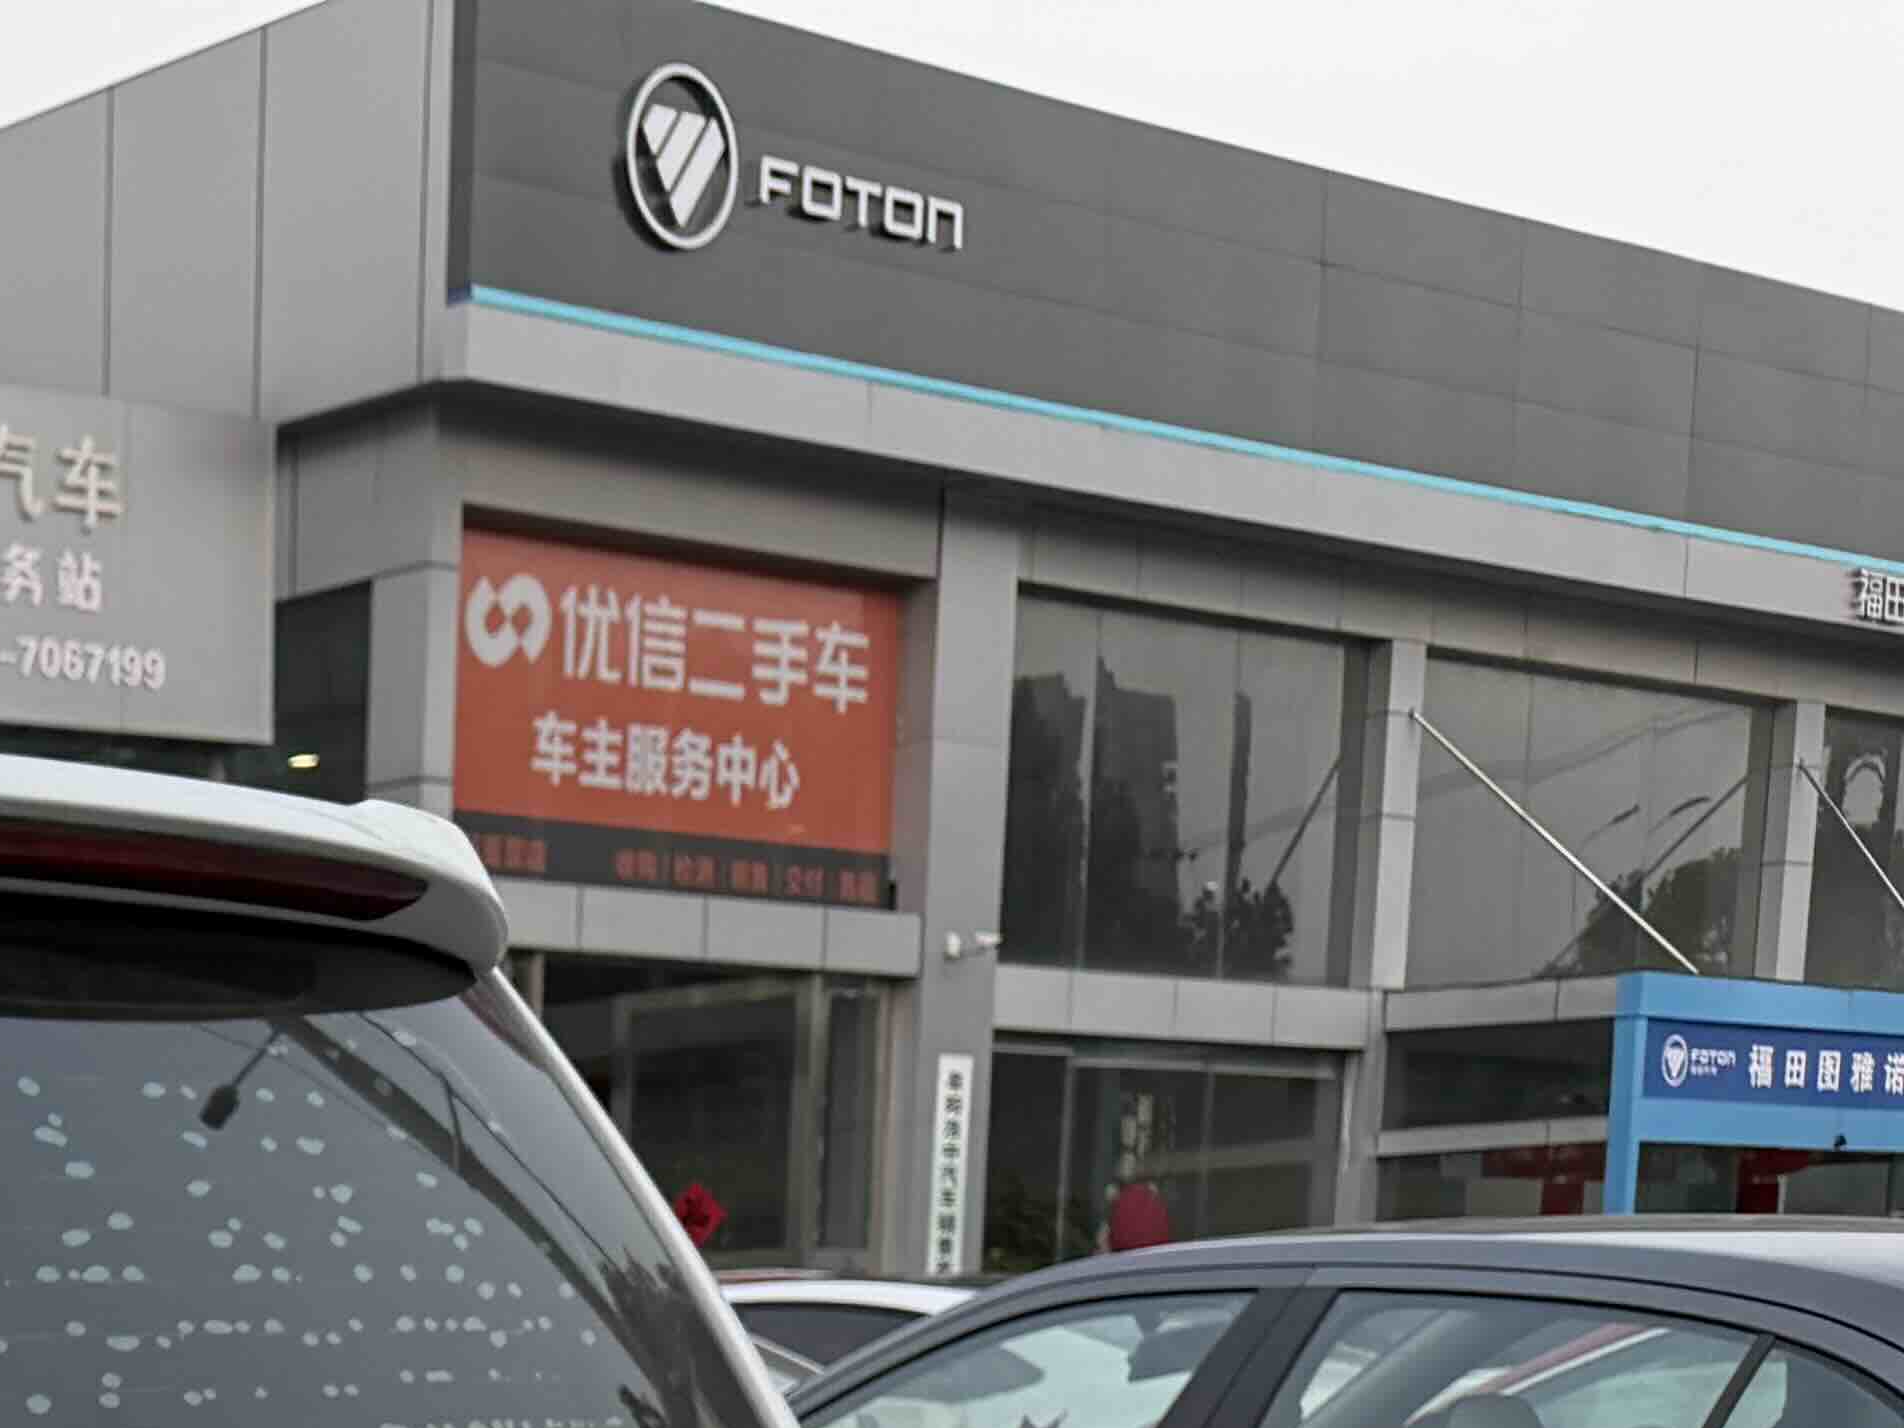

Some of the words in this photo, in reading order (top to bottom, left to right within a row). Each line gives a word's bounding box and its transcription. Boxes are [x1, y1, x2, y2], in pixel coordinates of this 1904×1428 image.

[759, 155, 964, 249] FOTON
[560, 584, 871, 713] 优信二手车
[530, 710, 801, 810] 车主服务中心
